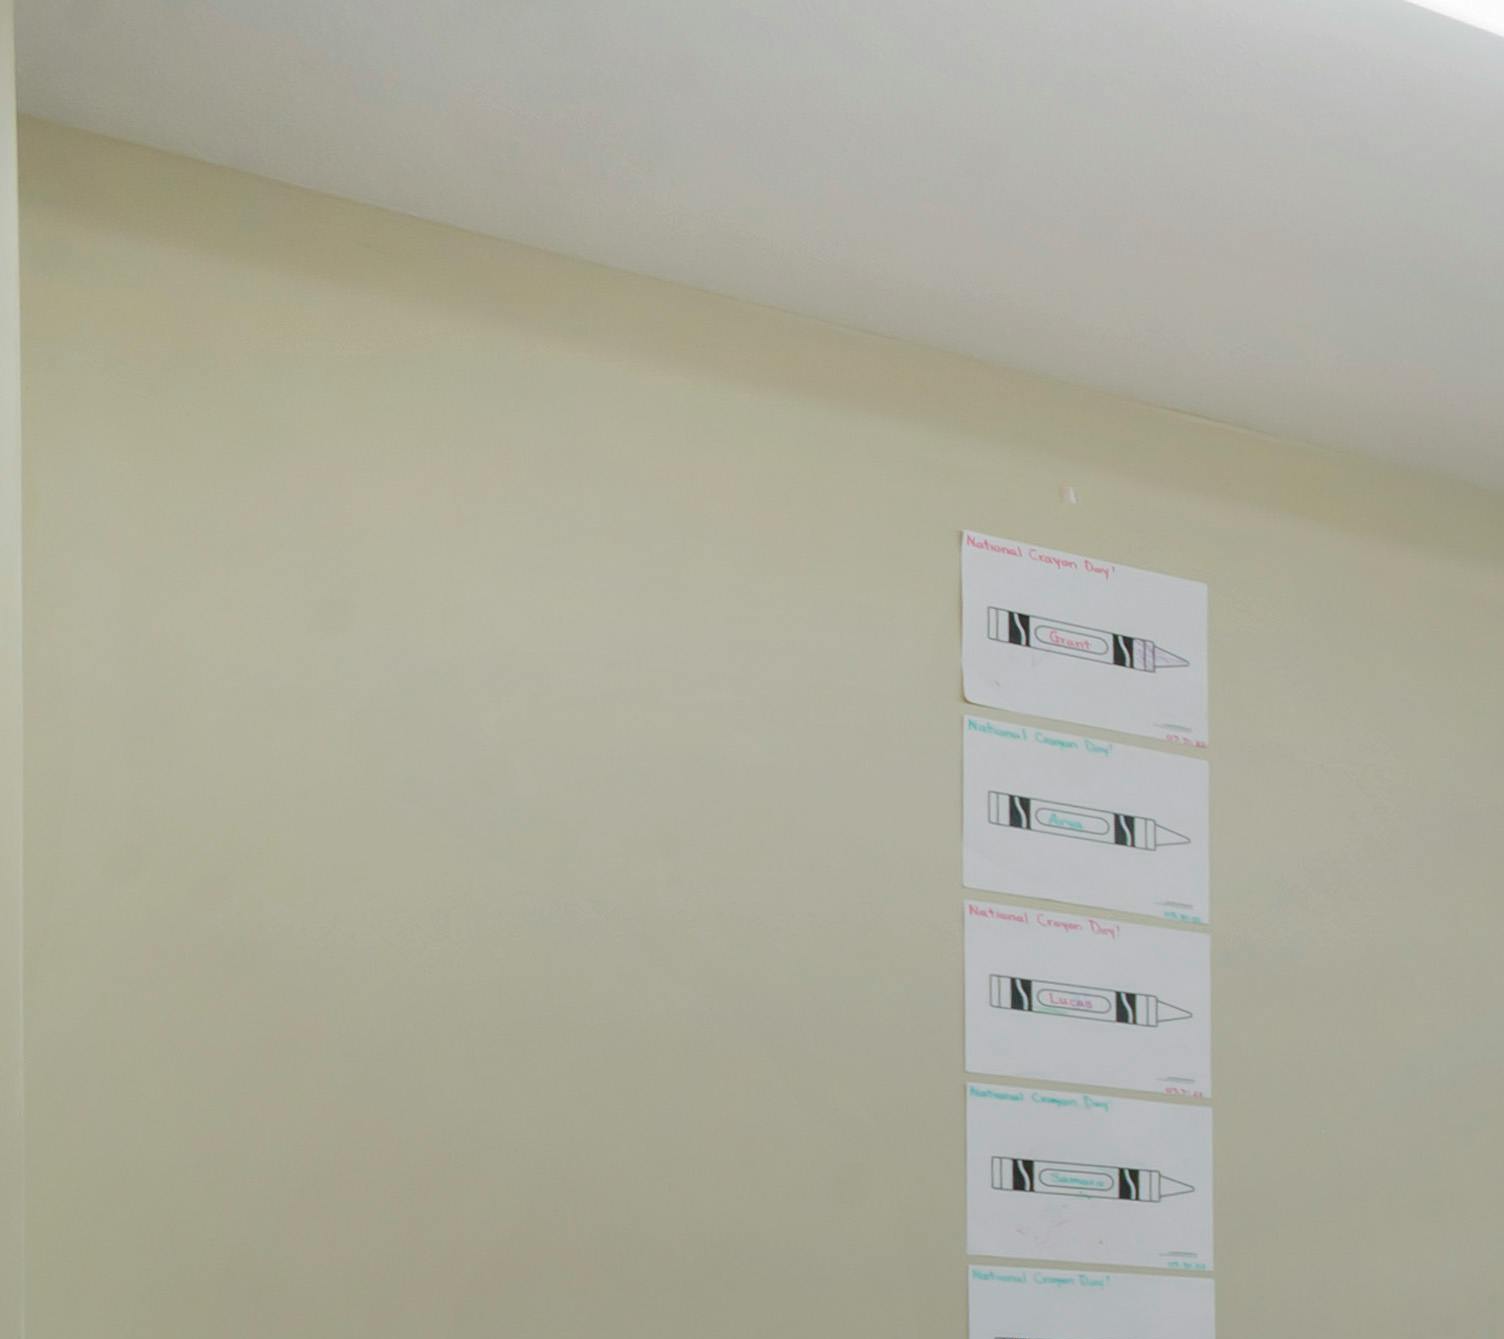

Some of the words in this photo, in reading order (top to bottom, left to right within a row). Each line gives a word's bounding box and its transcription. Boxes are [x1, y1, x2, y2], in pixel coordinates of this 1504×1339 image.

[967, 534, 1023, 558] National
[1028, 548, 1078, 570] Crayon
[1049, 629, 1090, 650] Grant
[968, 904, 1029, 924] National
[1036, 912, 1082, 933] Crayon
